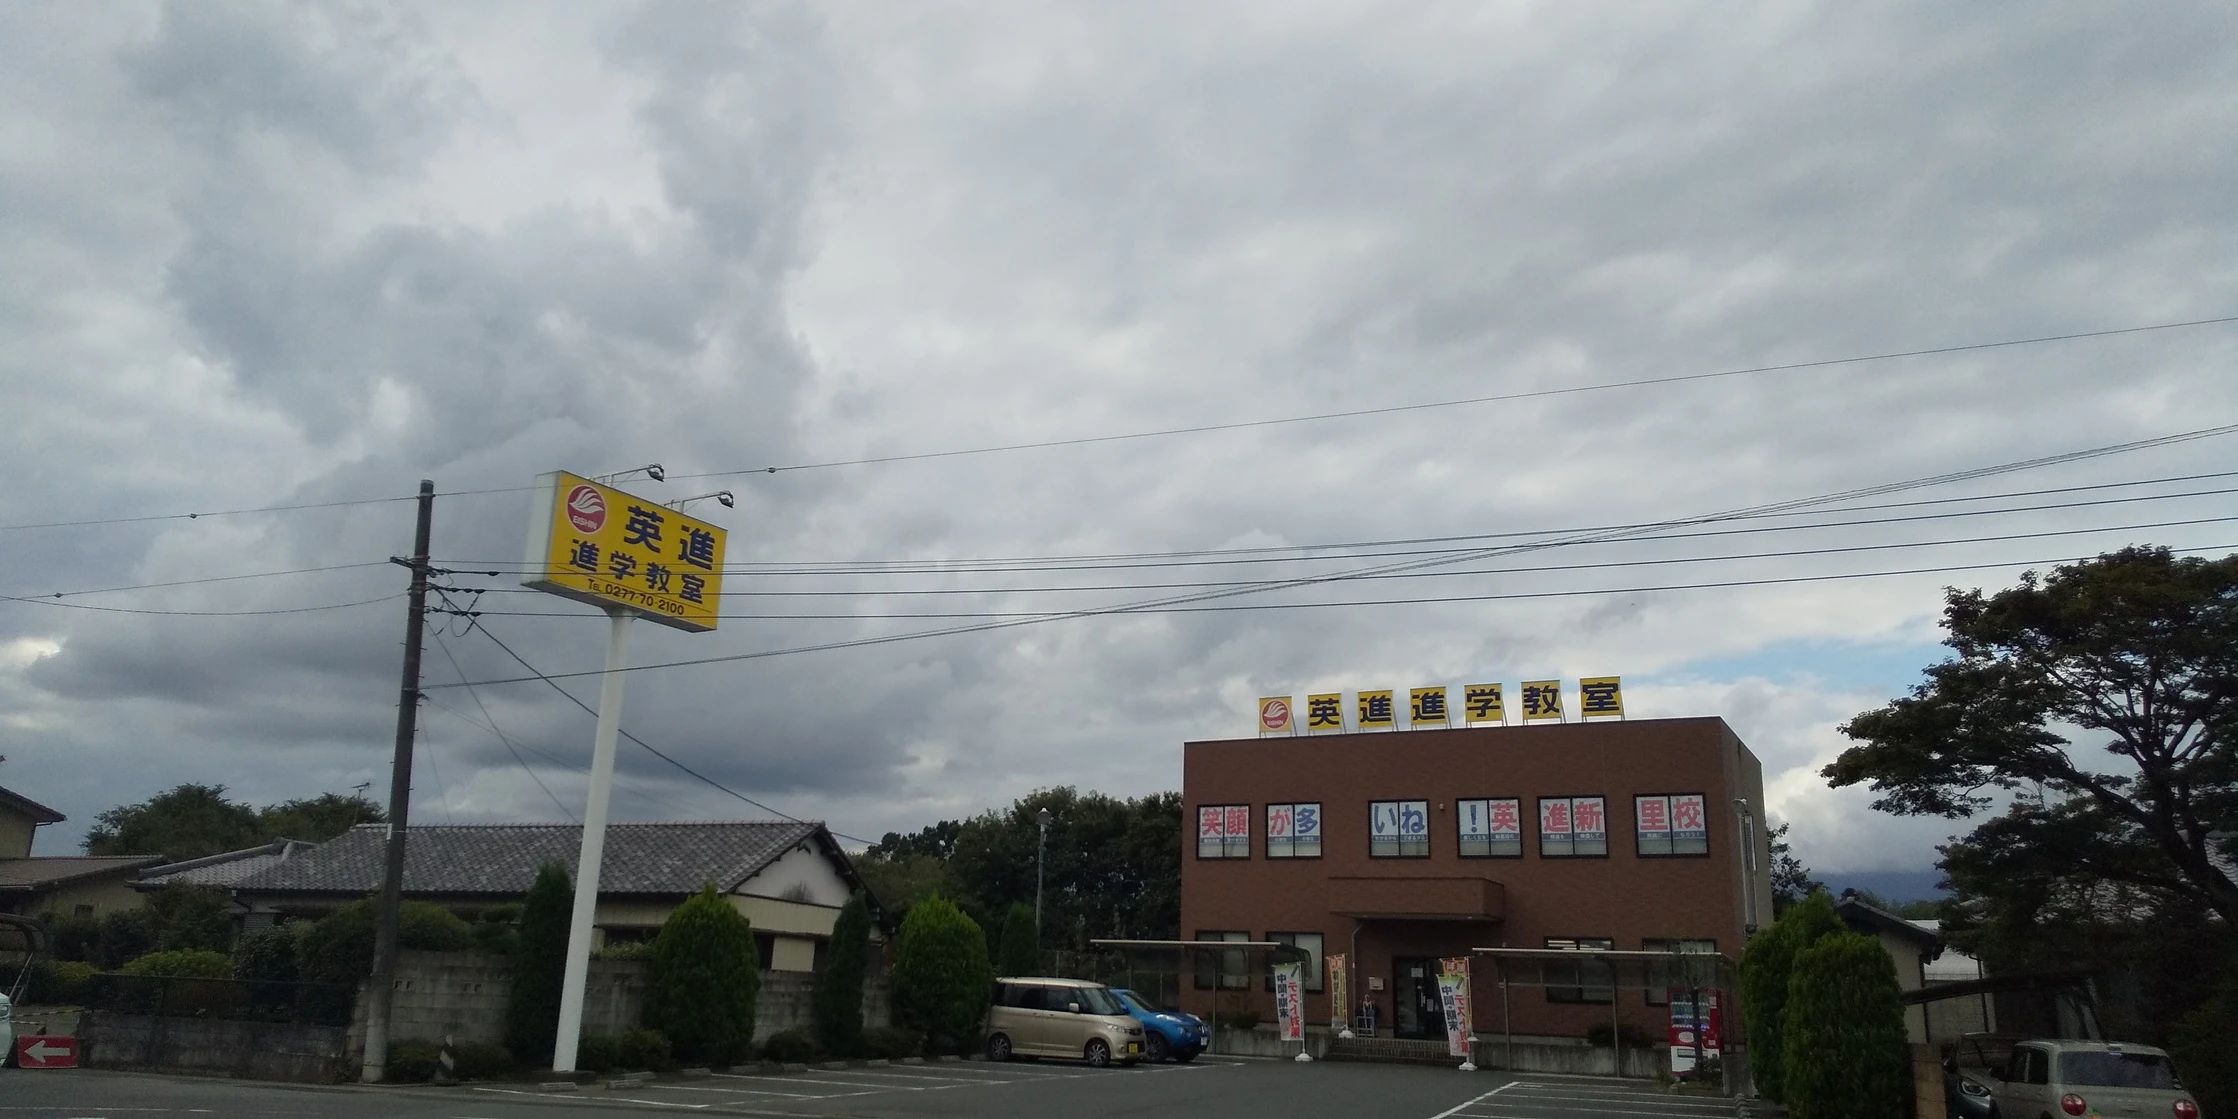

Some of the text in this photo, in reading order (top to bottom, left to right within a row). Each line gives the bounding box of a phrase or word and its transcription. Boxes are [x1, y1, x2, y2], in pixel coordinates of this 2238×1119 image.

[623, 505, 716, 571] 英進
[569, 539, 706, 605] 進学教室
[1308, 682, 1620, 727] 英進進学教室
